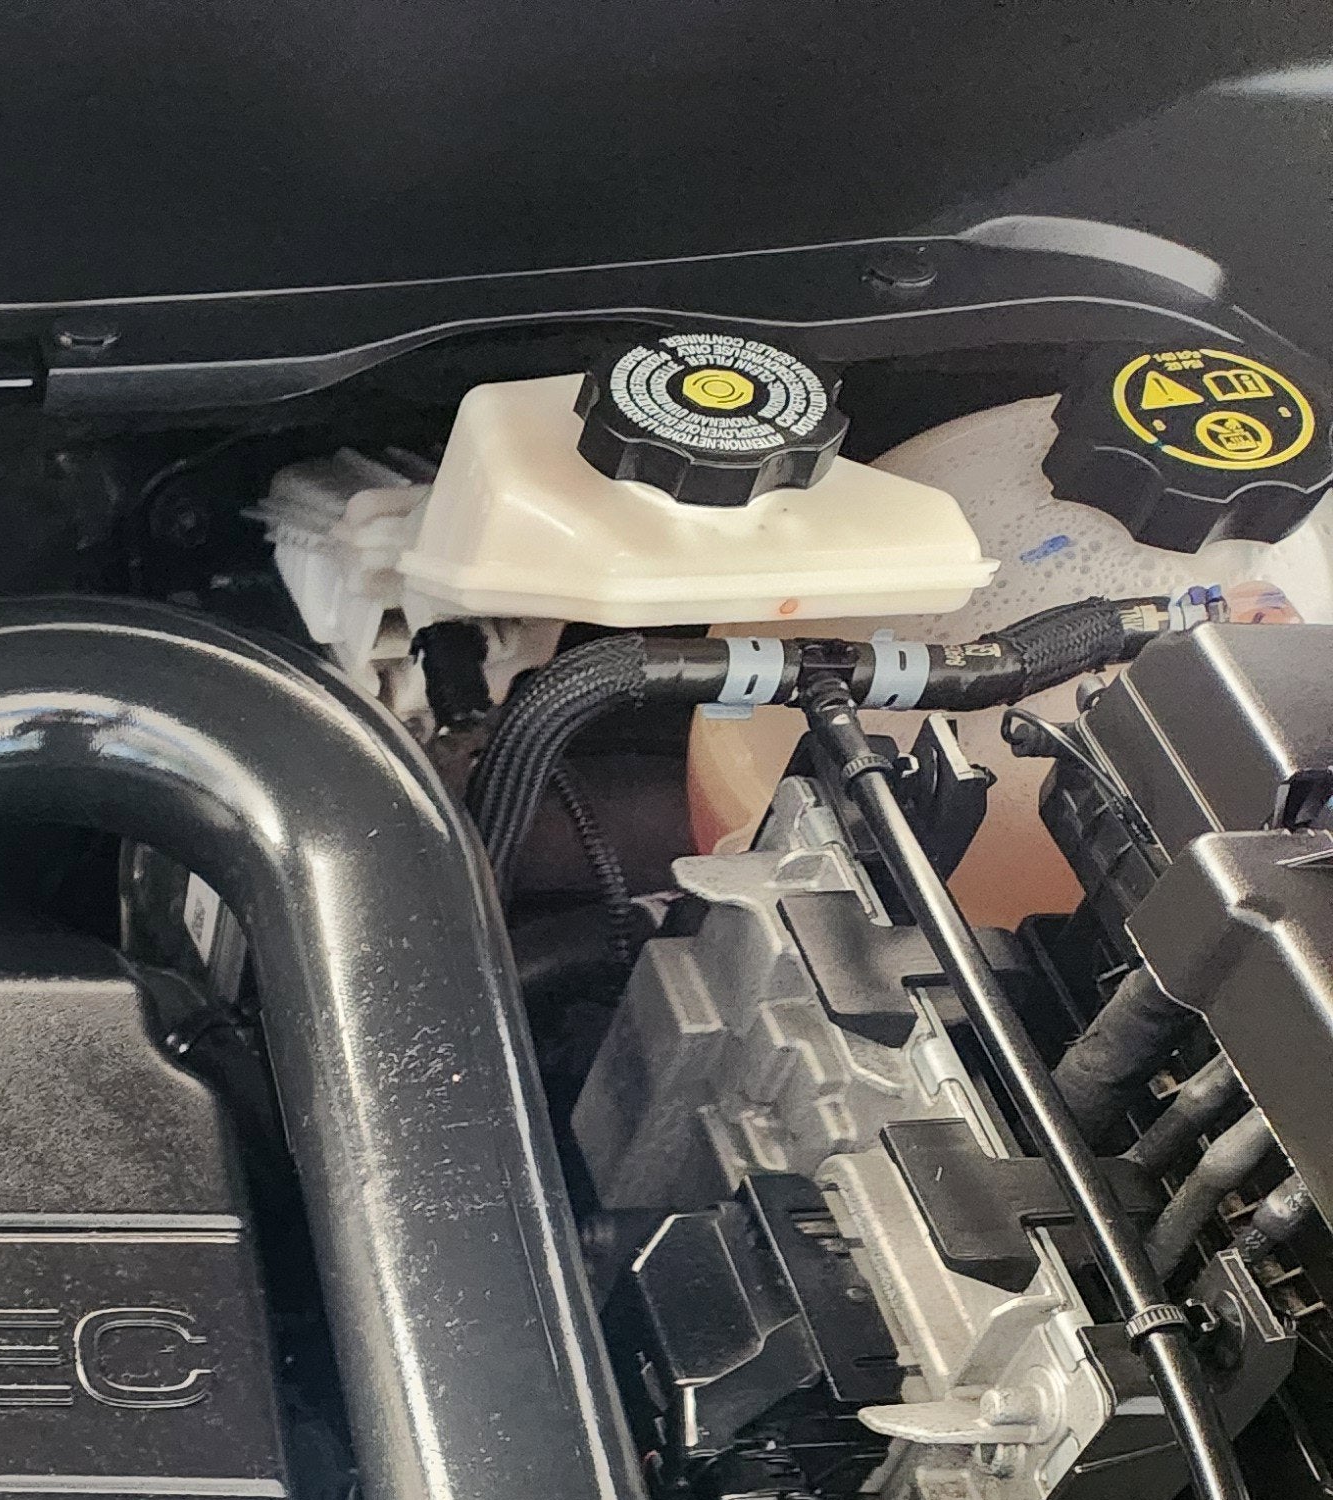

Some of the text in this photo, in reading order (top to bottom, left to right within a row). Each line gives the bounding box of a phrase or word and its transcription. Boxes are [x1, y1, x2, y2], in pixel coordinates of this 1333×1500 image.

[677, 344, 713, 357] ONLY
[714, 344, 740, 357] USE
[745, 340, 797, 366] SEALED
[684, 355, 734, 367] FILLER
[739, 348, 803, 384] REMOVING
[734, 360, 777, 383] CLEAN
[674, 419, 701, 432] QUE
[687, 412, 759, 428] PROVENANT
[790, 416, 818, 436] DOT
[654, 423, 718, 449] NETTOYER
